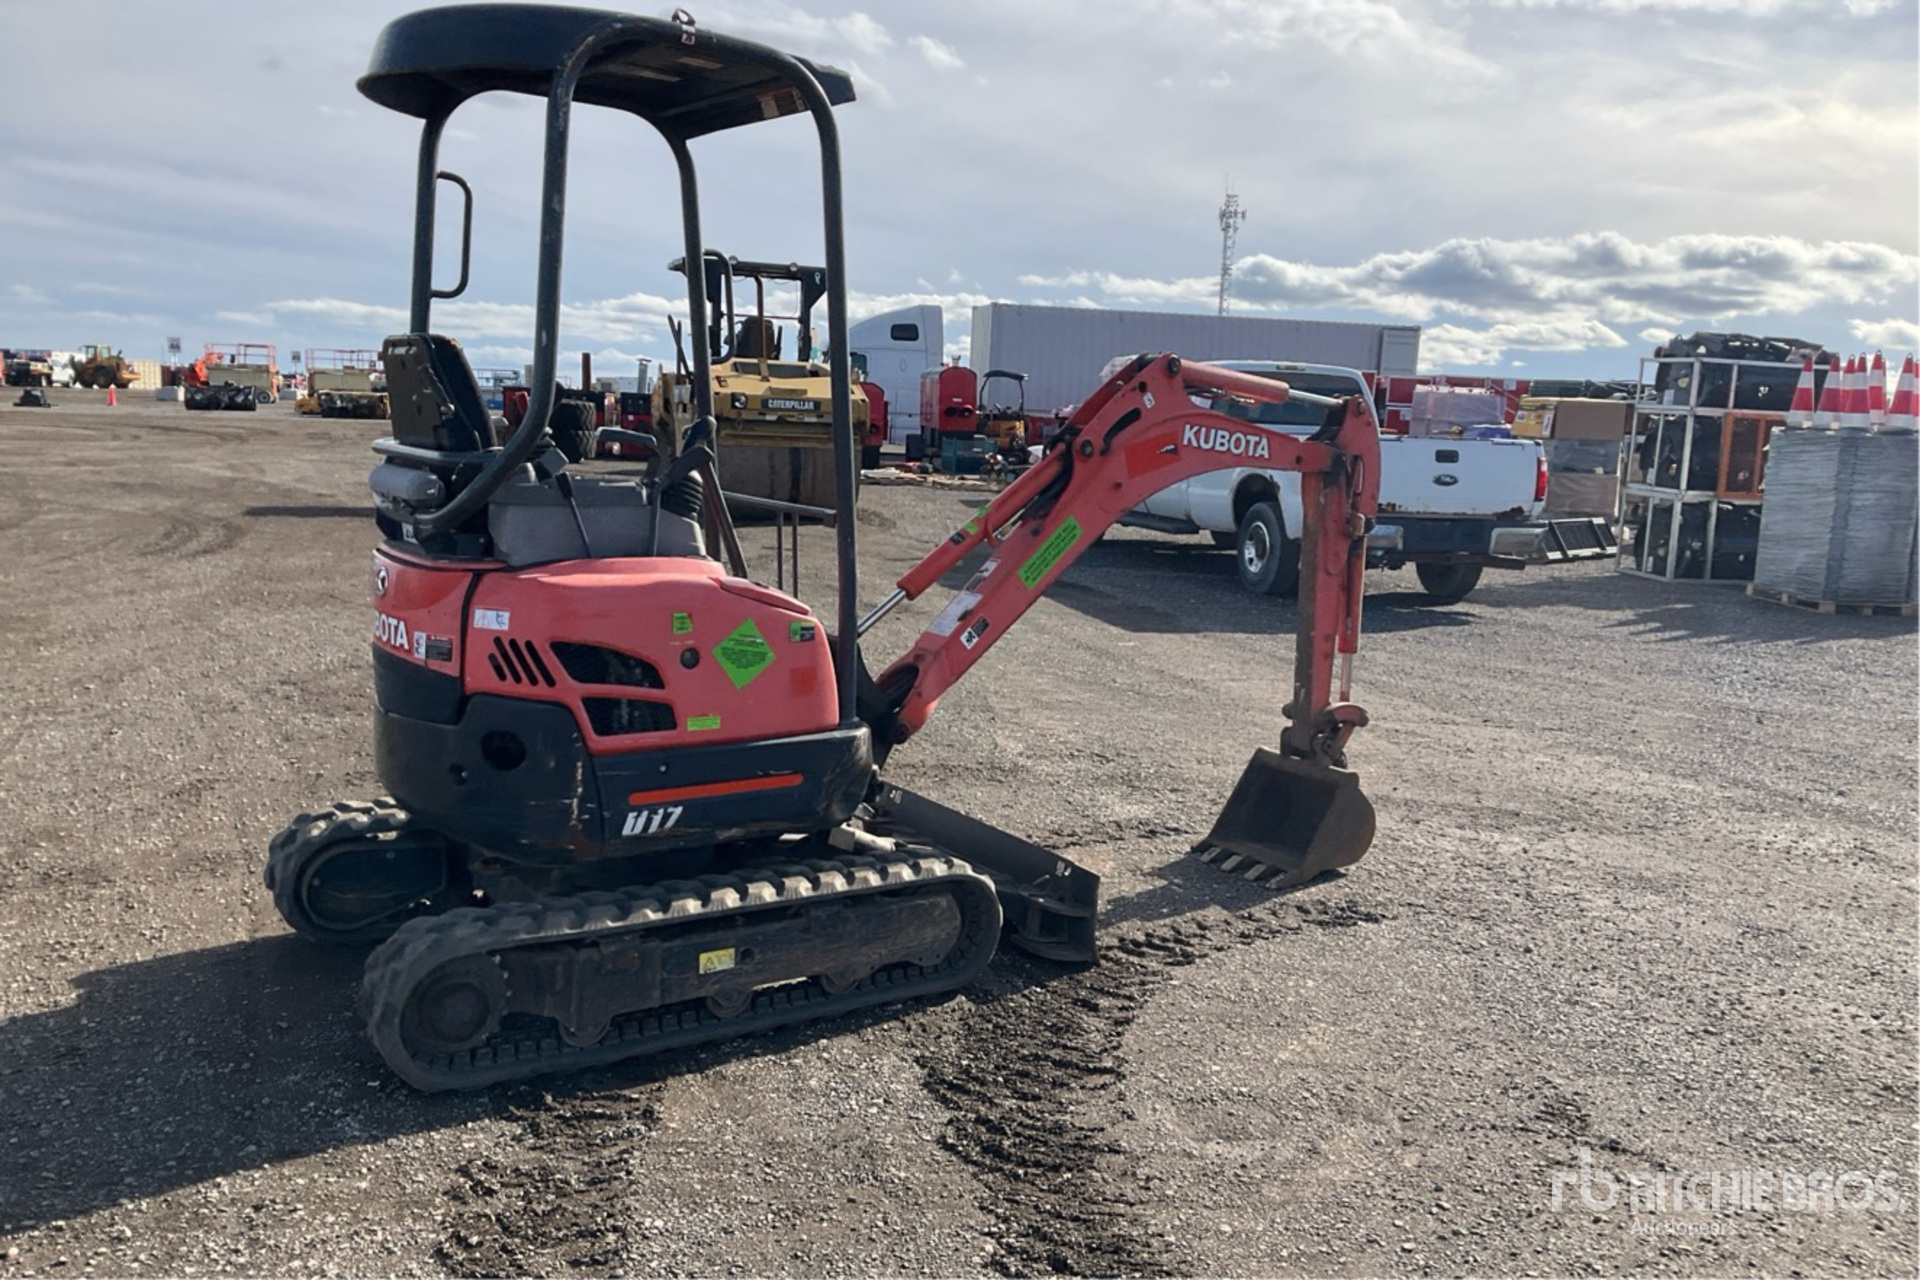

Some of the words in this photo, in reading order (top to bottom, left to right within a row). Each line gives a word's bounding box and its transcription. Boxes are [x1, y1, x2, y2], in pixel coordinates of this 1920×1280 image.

[768, 398, 815, 410] CATERPILLAR
[1182, 424, 1270, 459] KUBOTA
[621, 805, 684, 836] U17
